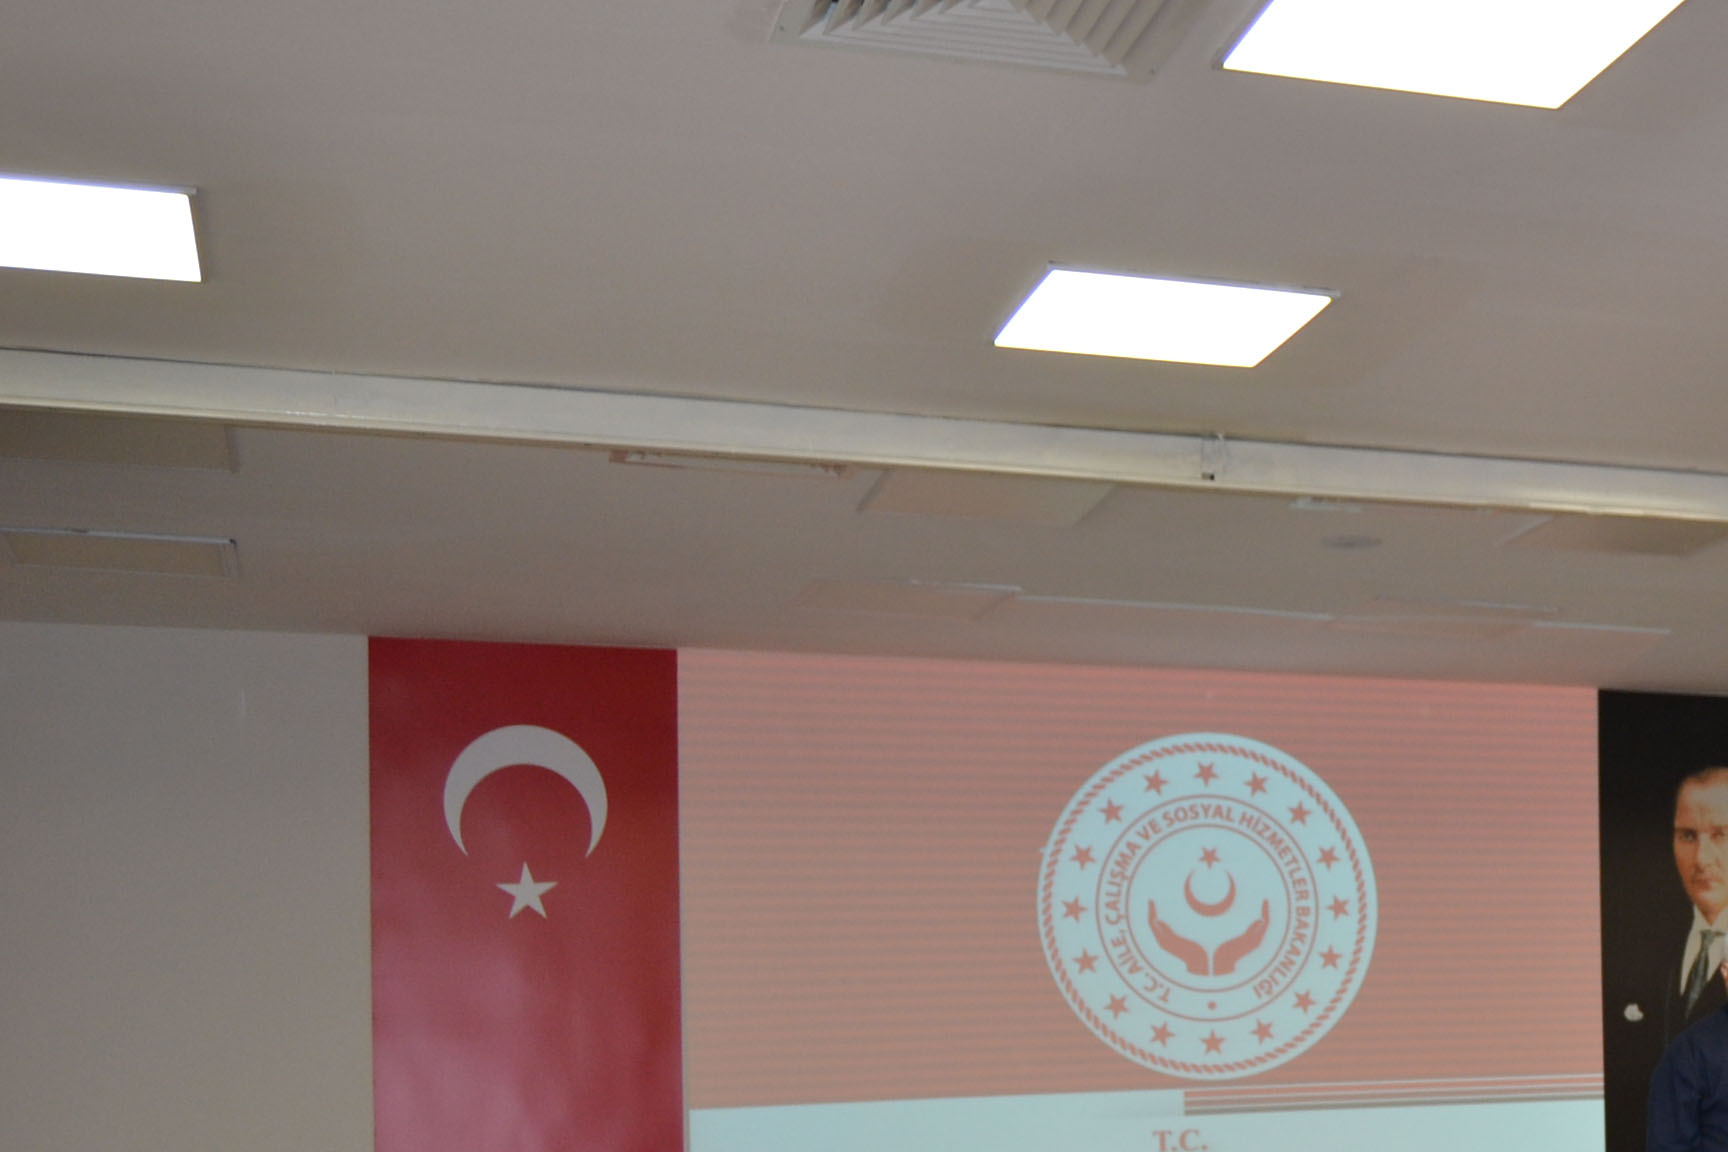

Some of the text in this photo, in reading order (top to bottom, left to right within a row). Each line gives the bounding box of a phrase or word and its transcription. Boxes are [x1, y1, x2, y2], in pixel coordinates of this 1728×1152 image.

[1136, 818, 1163, 841] VE
[1161, 803, 1236, 828] SOSYAL
[1238, 811, 1310, 900] HİZMETLER
[1105, 840, 1142, 925] ÇALIŞMA
[1252, 905, 1311, 1000] BAKANLIĞI
